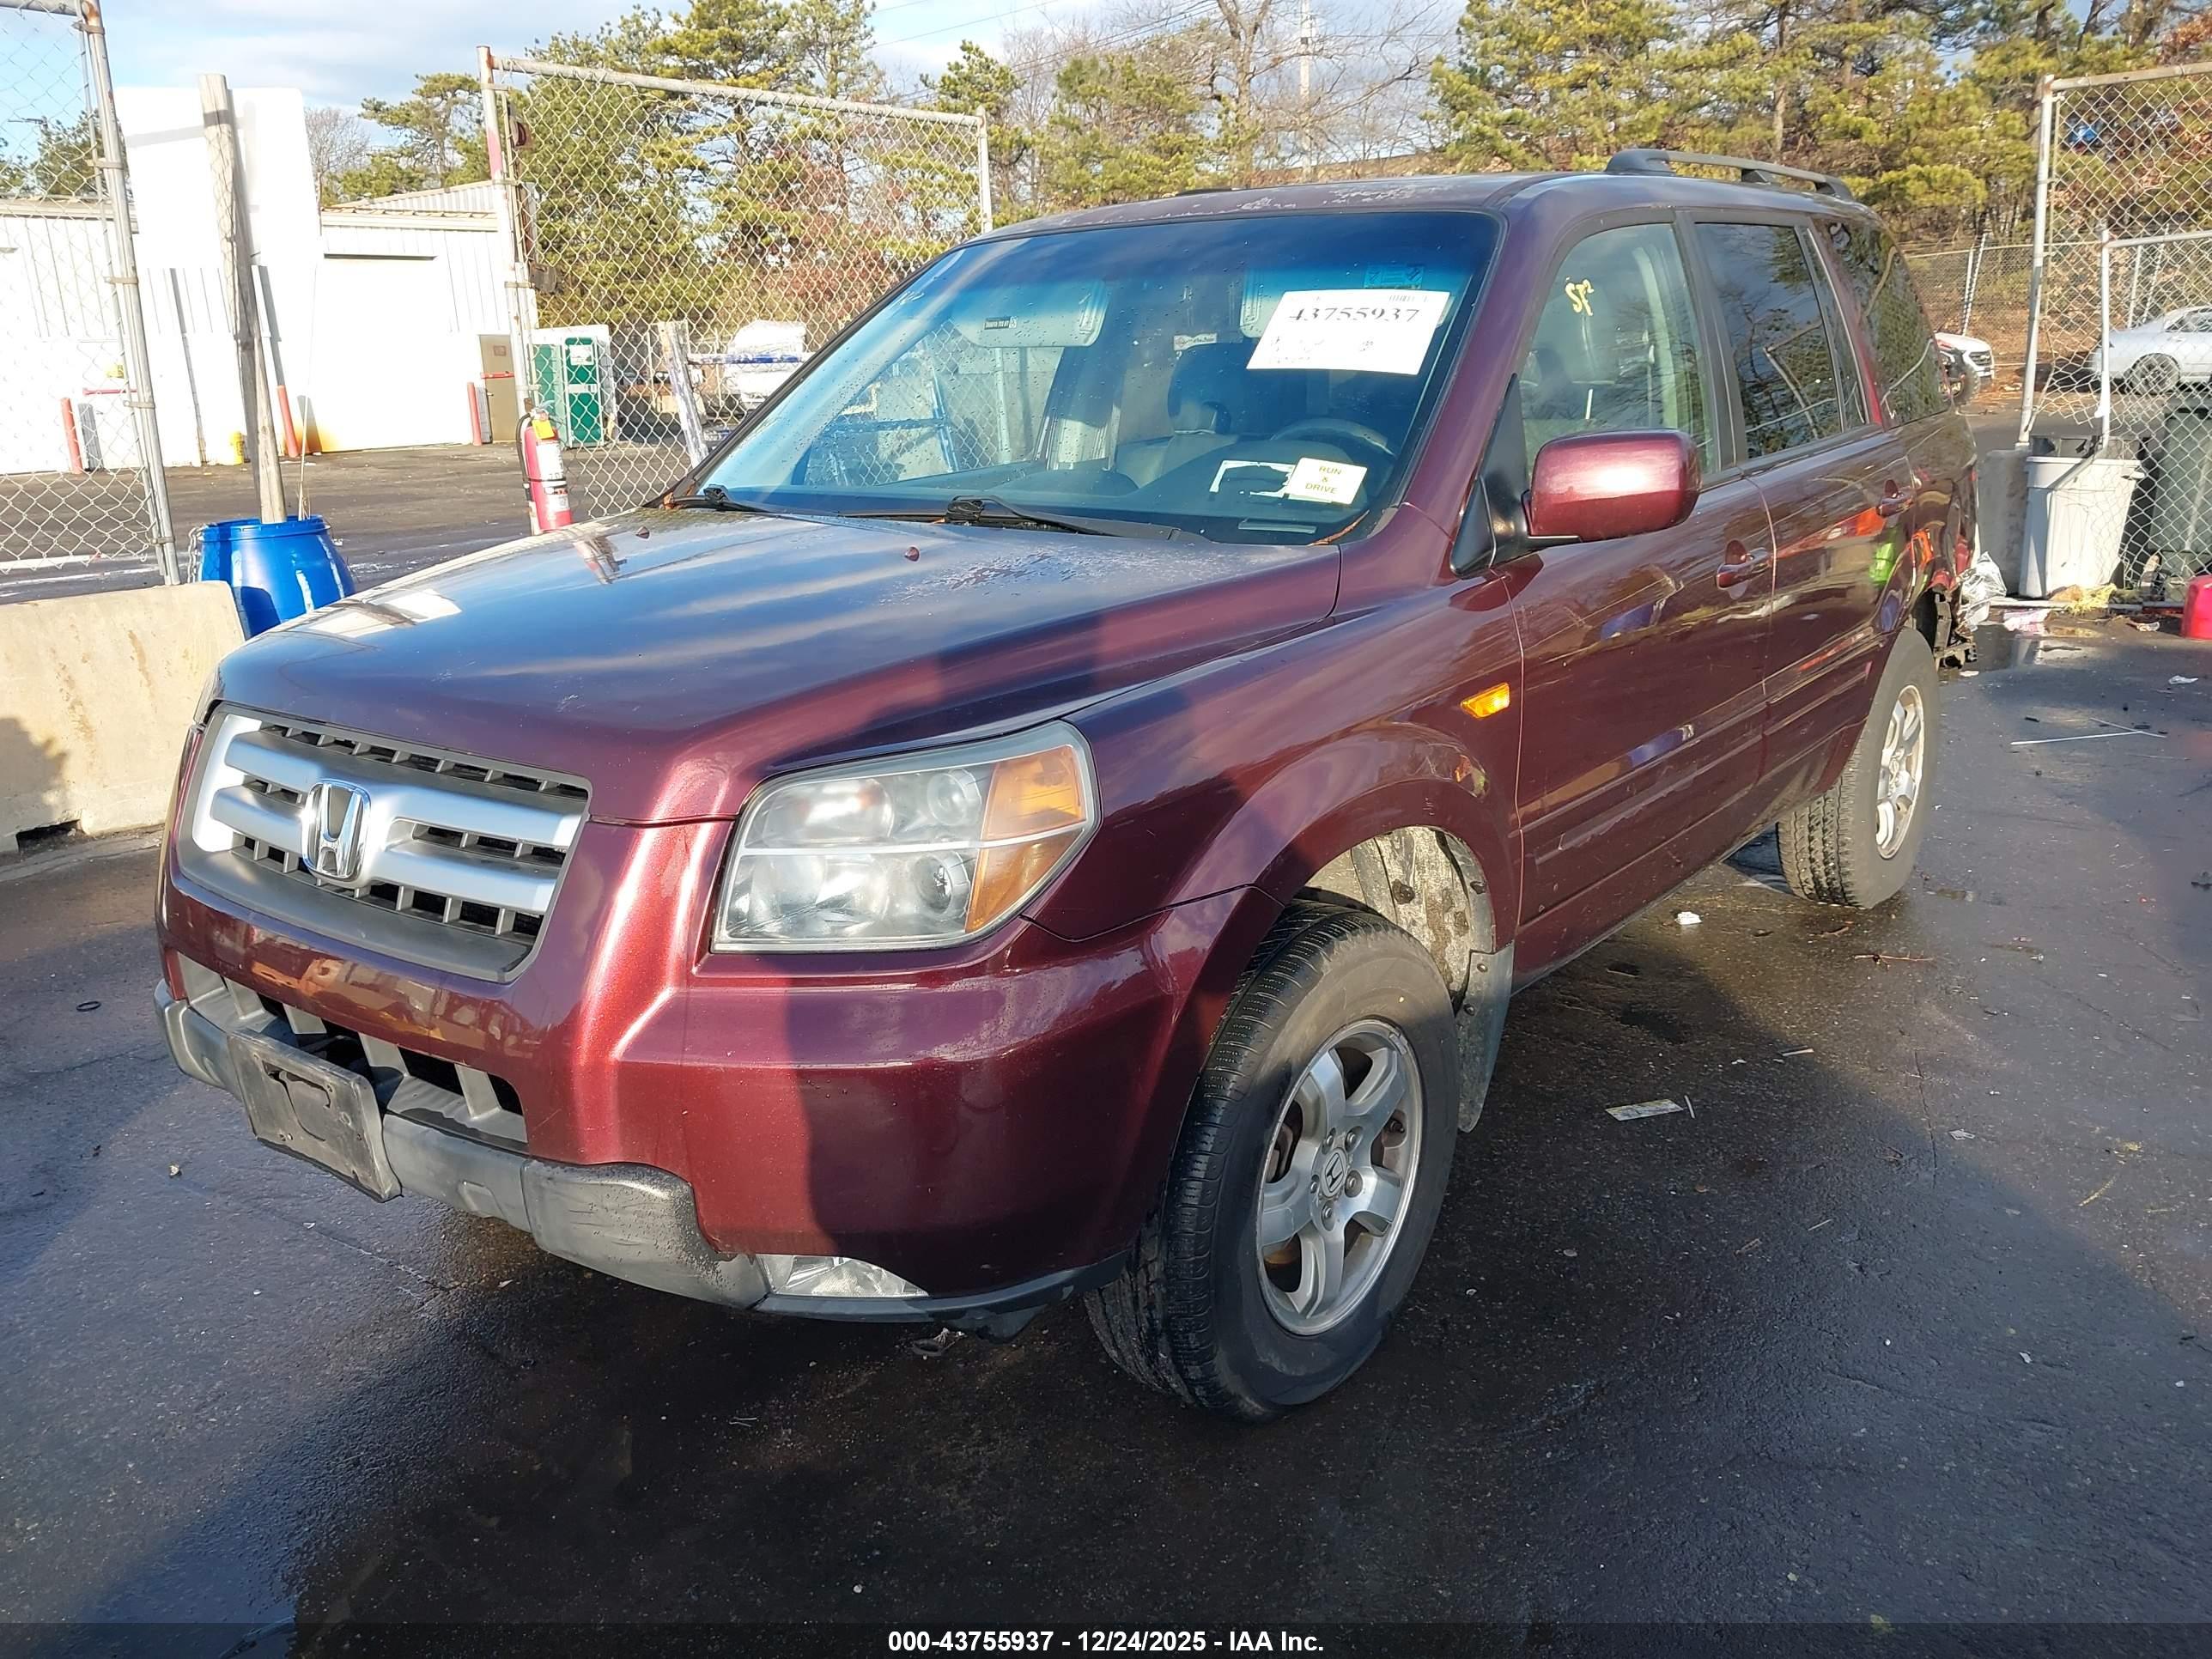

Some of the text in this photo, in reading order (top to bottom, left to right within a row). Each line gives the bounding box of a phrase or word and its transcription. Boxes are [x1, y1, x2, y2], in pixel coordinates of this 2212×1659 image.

[1288, 307, 1419, 322] 43755937
[1319, 465, 1342, 475] RUN
[1305, 483, 1338, 494] DRIVE
